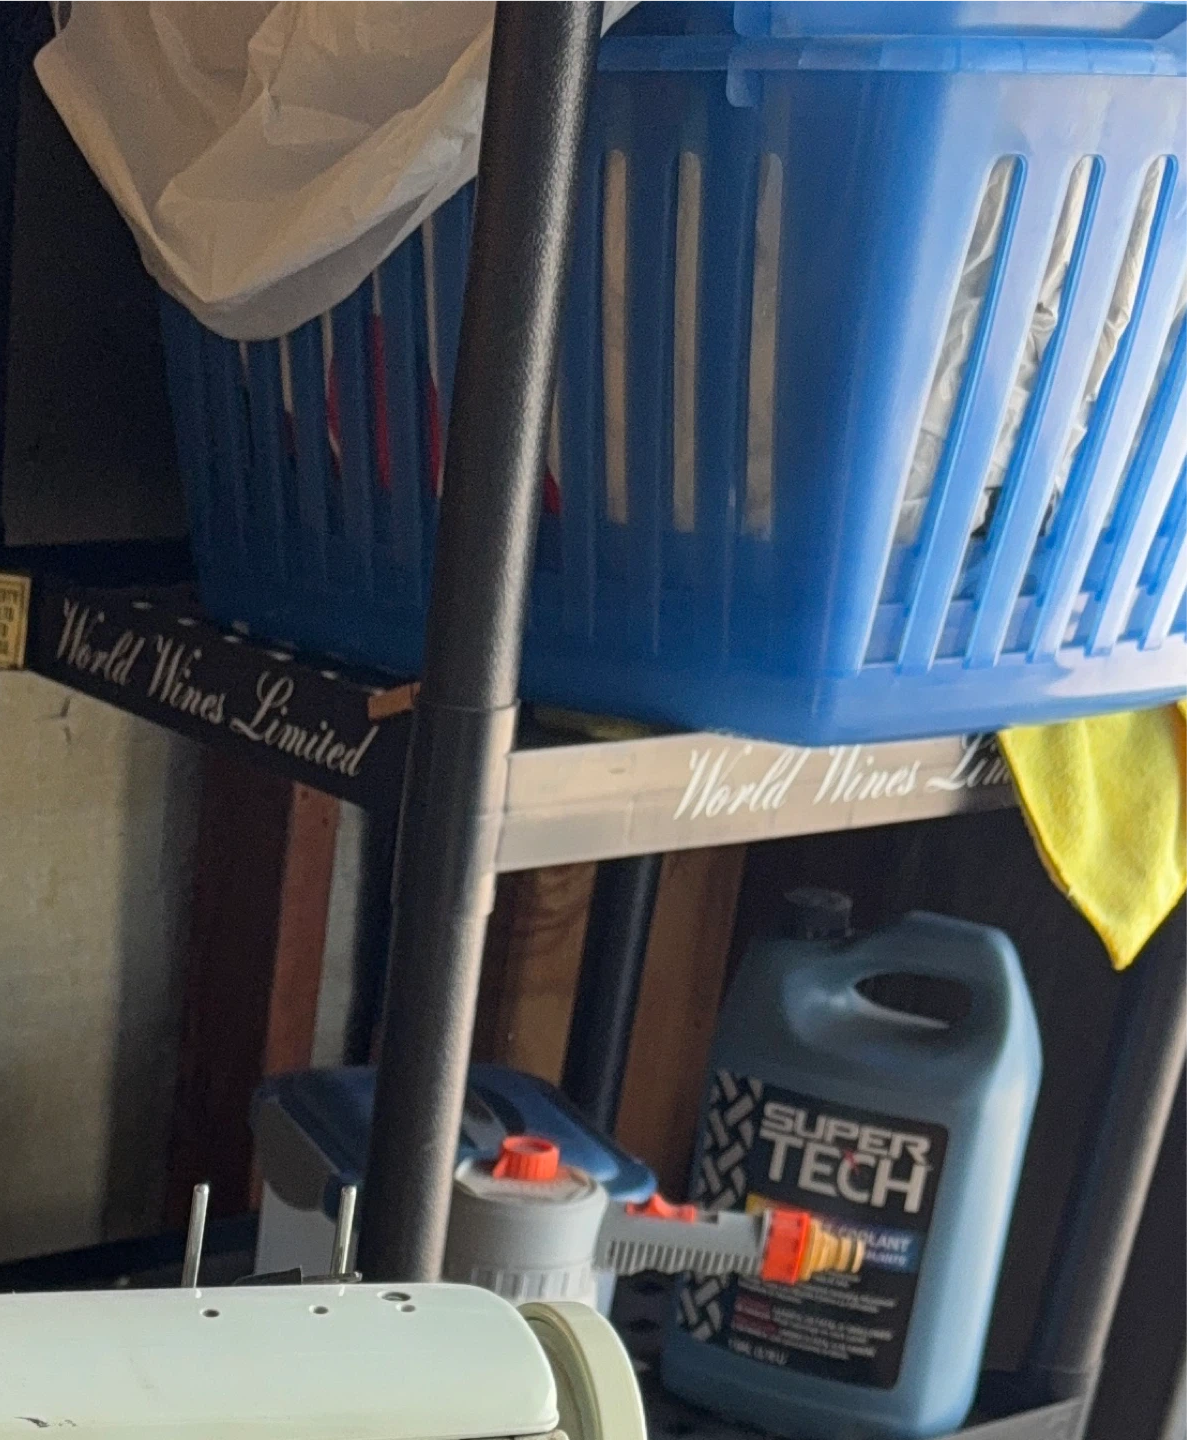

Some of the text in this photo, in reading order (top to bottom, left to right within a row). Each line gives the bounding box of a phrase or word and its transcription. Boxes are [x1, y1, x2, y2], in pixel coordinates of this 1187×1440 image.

[56, 596, 380, 778] World Wines Limited
[673, 733, 1013, 821] World Wines Lim
[759, 1129, 930, 1214] TECH
[762, 1101, 932, 1165] SUPER
